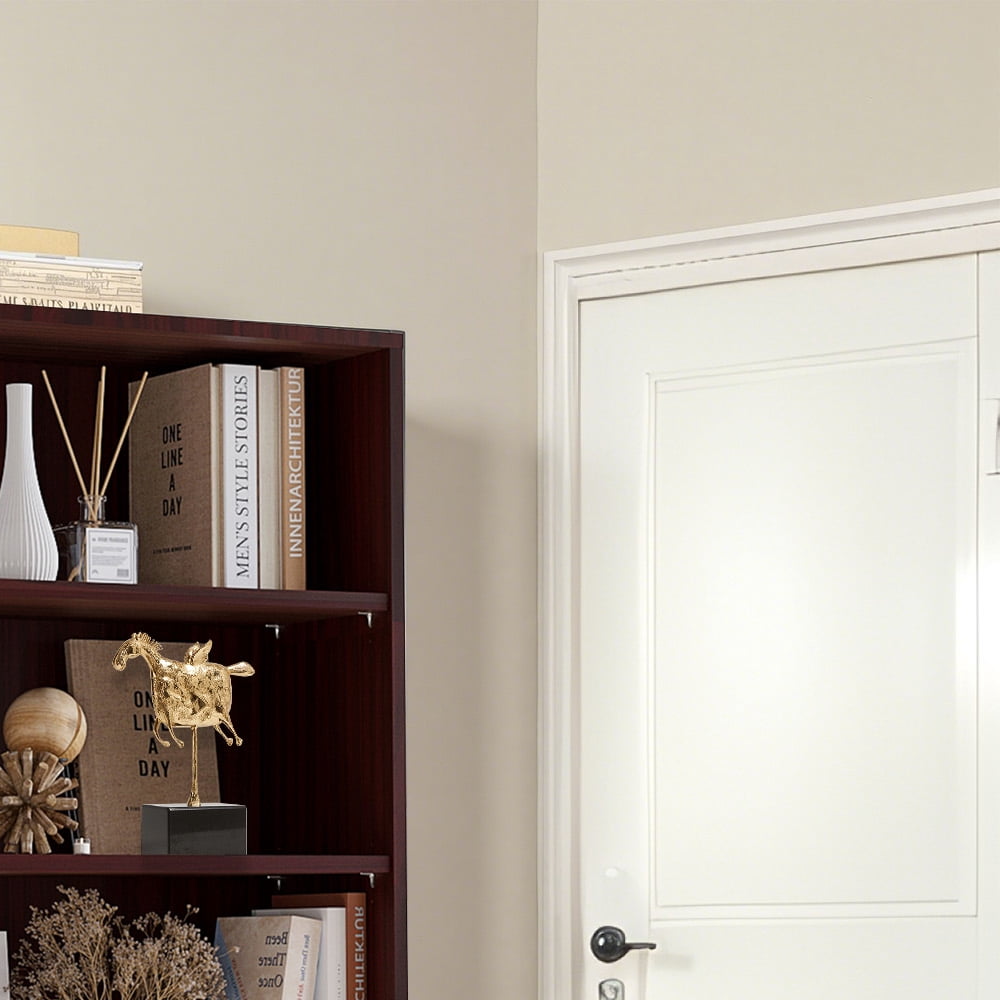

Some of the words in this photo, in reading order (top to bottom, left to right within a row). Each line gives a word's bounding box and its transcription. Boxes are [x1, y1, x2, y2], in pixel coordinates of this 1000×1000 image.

[234, 375, 249, 454] STORIES
[162, 423, 182, 443] ONE
[161, 447, 183, 469] LINE
[288, 367, 303, 558] INNENARCHITEKTUR
[169, 474, 176, 492] A
[234, 458, 249, 517] STYLE
[162, 496, 183, 517] DAY
[235, 521, 250, 578] MEN'S
[134, 690, 153, 708] ON
[148, 738, 159, 754] A
[138, 760, 170, 778] DAY
